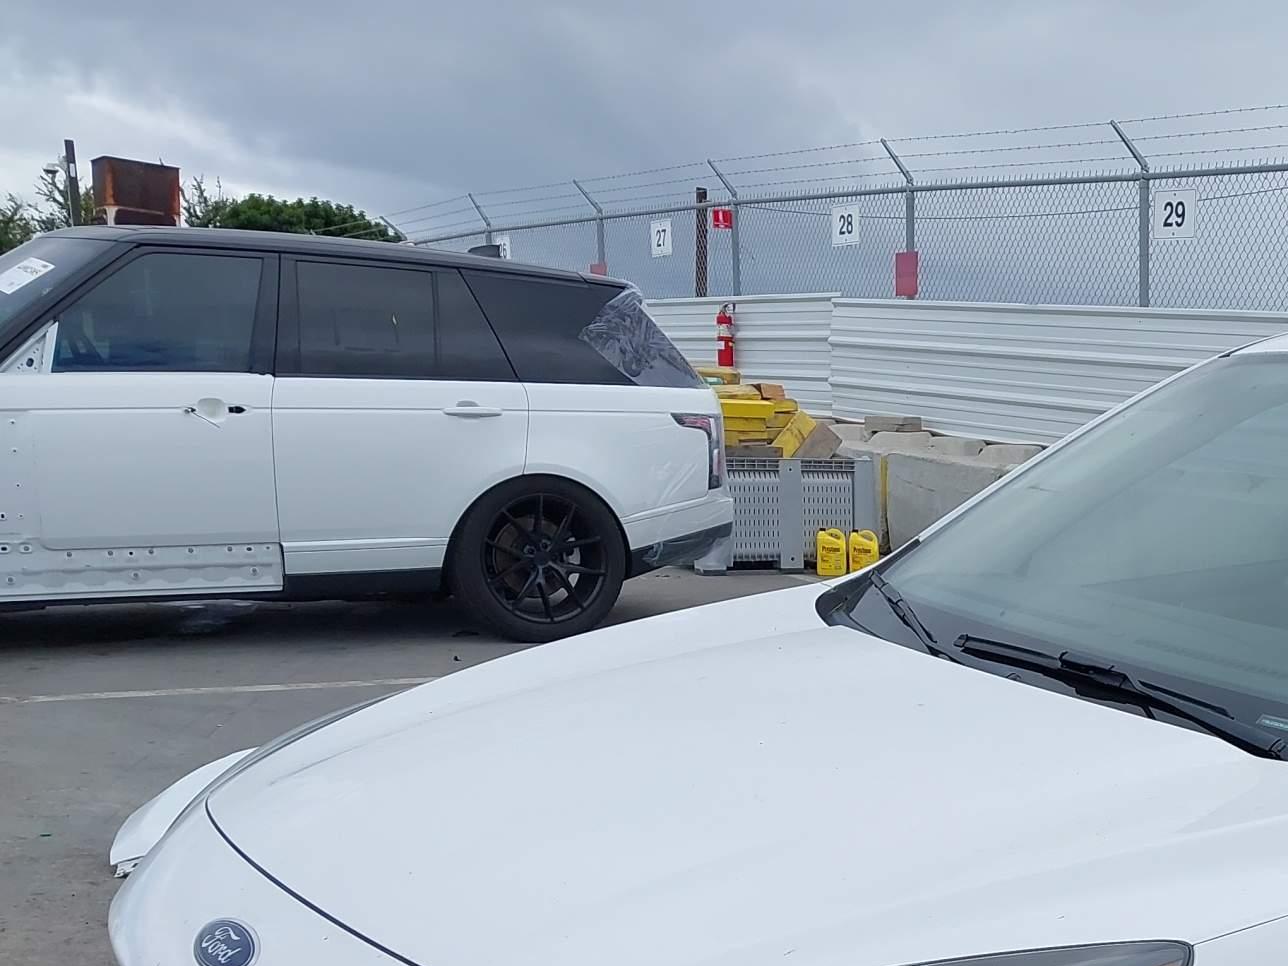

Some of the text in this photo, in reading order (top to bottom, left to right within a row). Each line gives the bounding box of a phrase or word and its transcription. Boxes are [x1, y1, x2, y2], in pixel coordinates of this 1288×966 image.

[838, 213, 854, 236] 28
[1163, 201, 1186, 227] 29
[655, 228, 667, 248] 27
[201, 926, 242, 964] Ford
